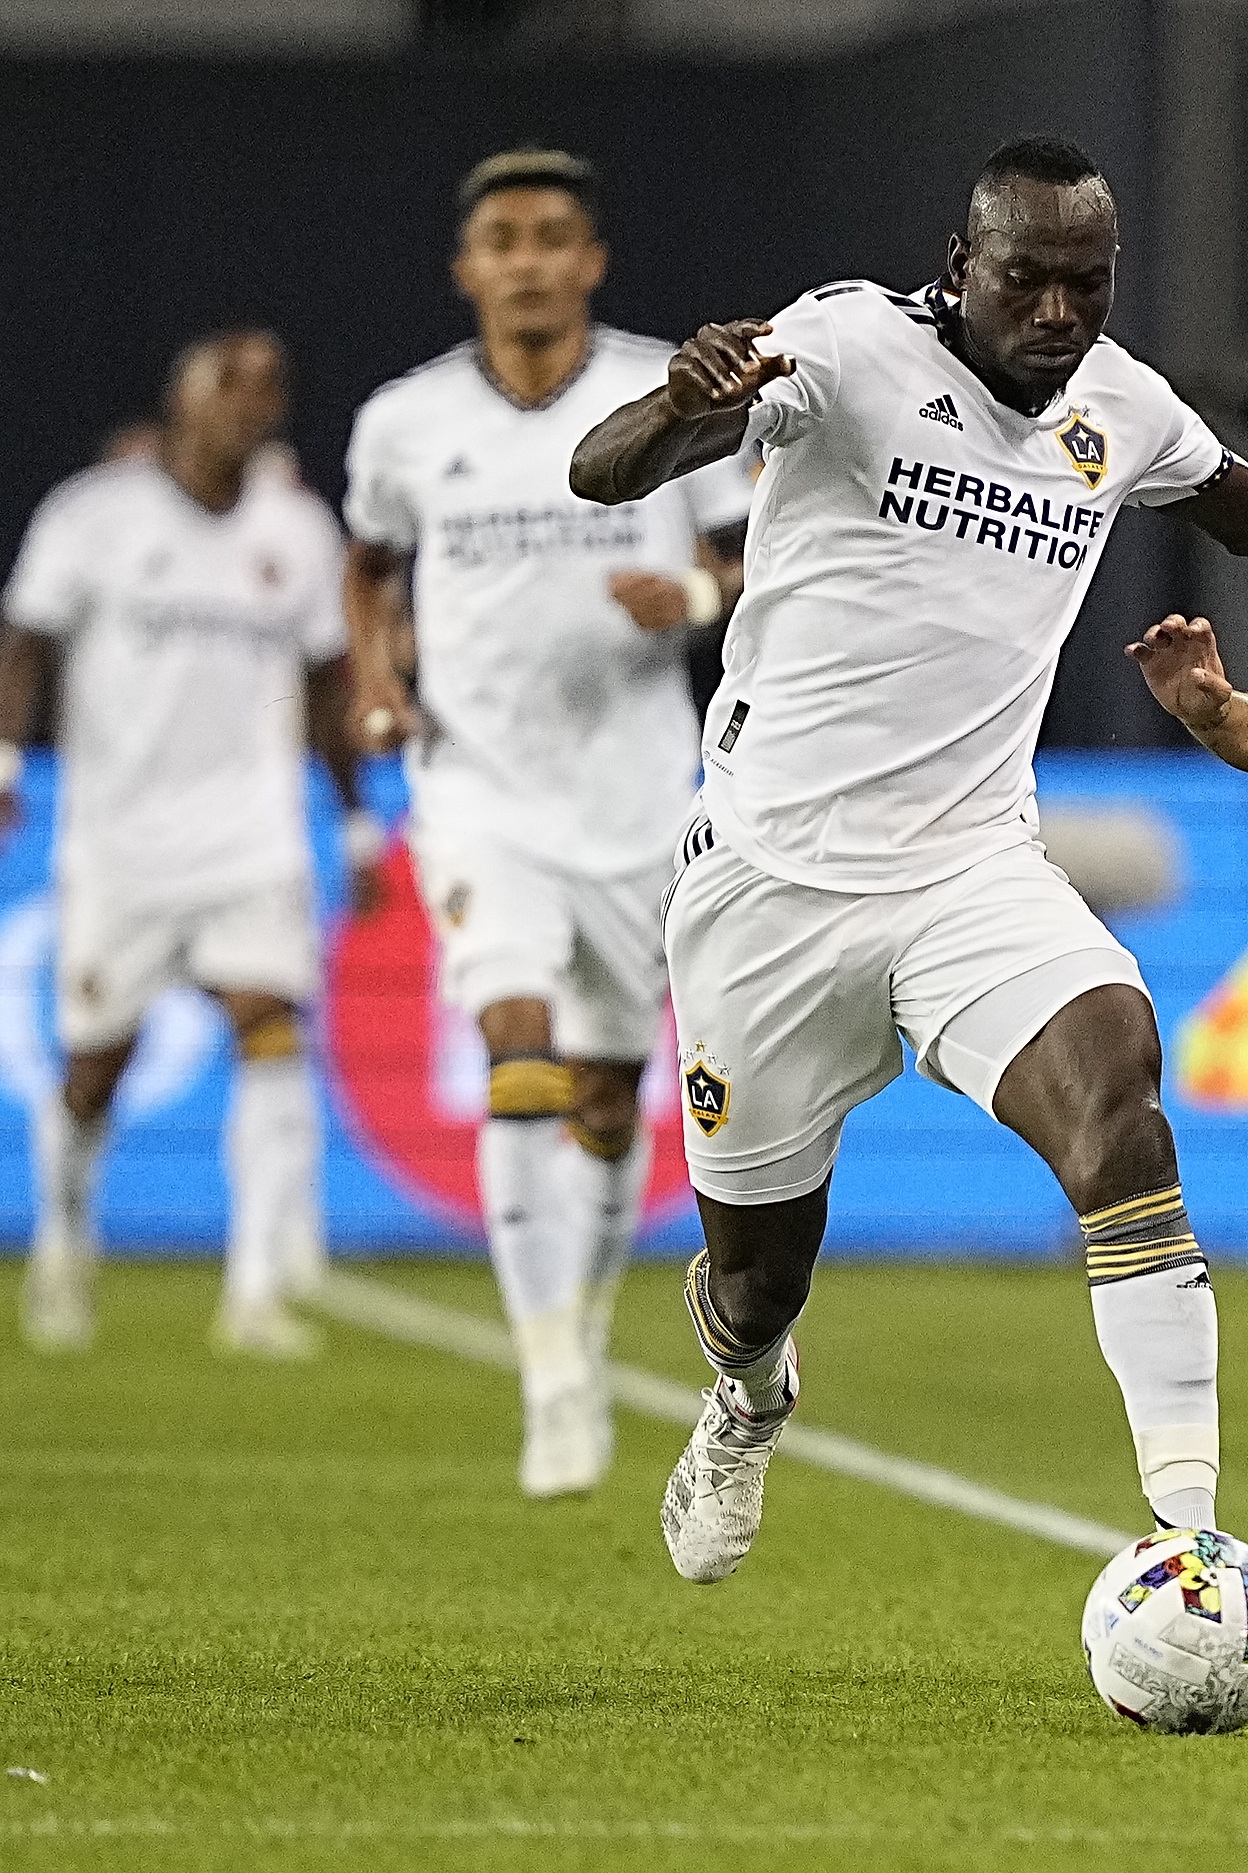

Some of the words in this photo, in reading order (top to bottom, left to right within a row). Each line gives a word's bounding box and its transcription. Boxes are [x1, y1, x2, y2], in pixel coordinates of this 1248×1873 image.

[919, 407, 964, 432] adidas
[1071, 440, 1101, 462] LA
[888, 457, 1105, 538] HERBALIFE
[691, 1085, 719, 1110] LA
